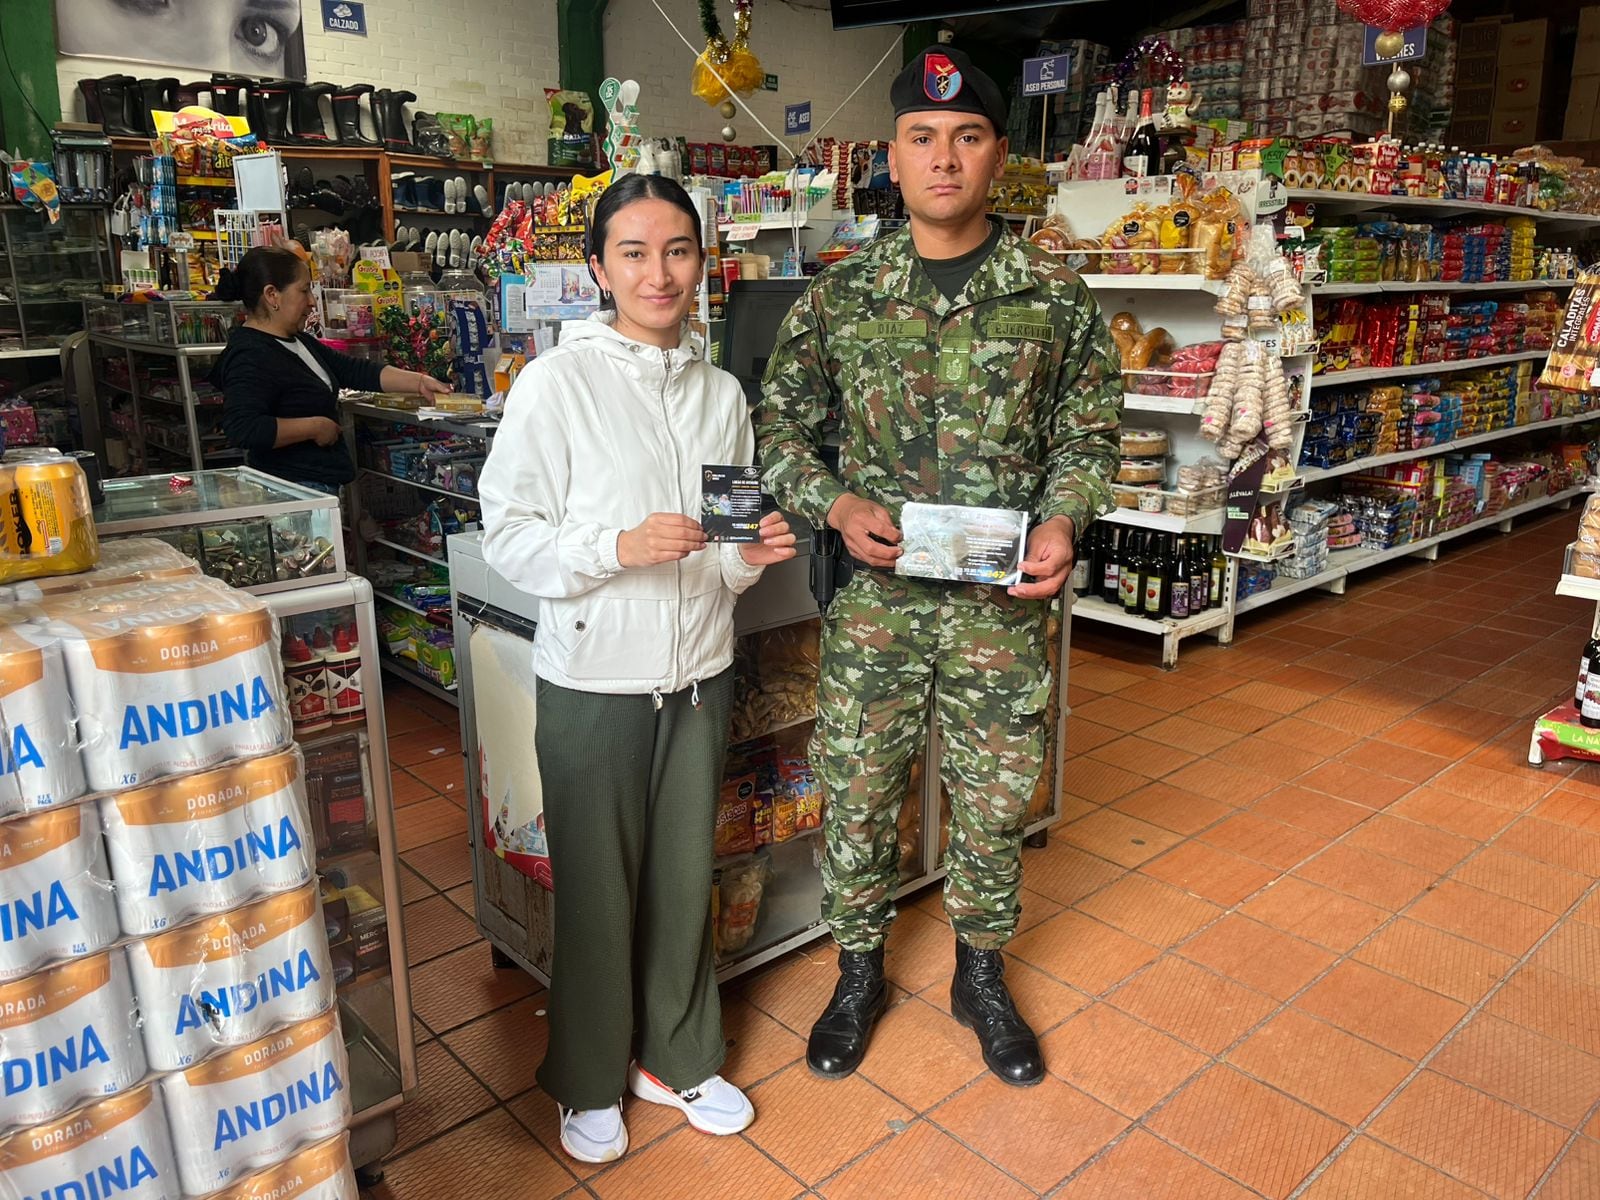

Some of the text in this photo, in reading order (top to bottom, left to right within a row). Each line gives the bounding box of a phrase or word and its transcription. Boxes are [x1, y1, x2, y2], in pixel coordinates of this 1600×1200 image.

[329, 17, 359, 30] CALZADO
[1040, 79, 1066, 91] PERSONAL
[1556, 288, 1587, 348] CALADITAS
[1568, 296, 1592, 342] INTEGRALES
[160, 639, 220, 661] DORADA
[119, 675, 275, 750] ANDINA
[121, 772, 137, 785] X6
[186, 785, 243, 811] DORADA
[149, 815, 302, 897] ANDINA
[151, 917, 167, 930] X6
[211, 922, 268, 952] DORADA
[174, 948, 321, 1036] ANDINA
[243, 1036, 296, 1067] DORADA
[214, 1060, 344, 1151] ANDINA
[31, 1118, 93, 1152] DORADA
